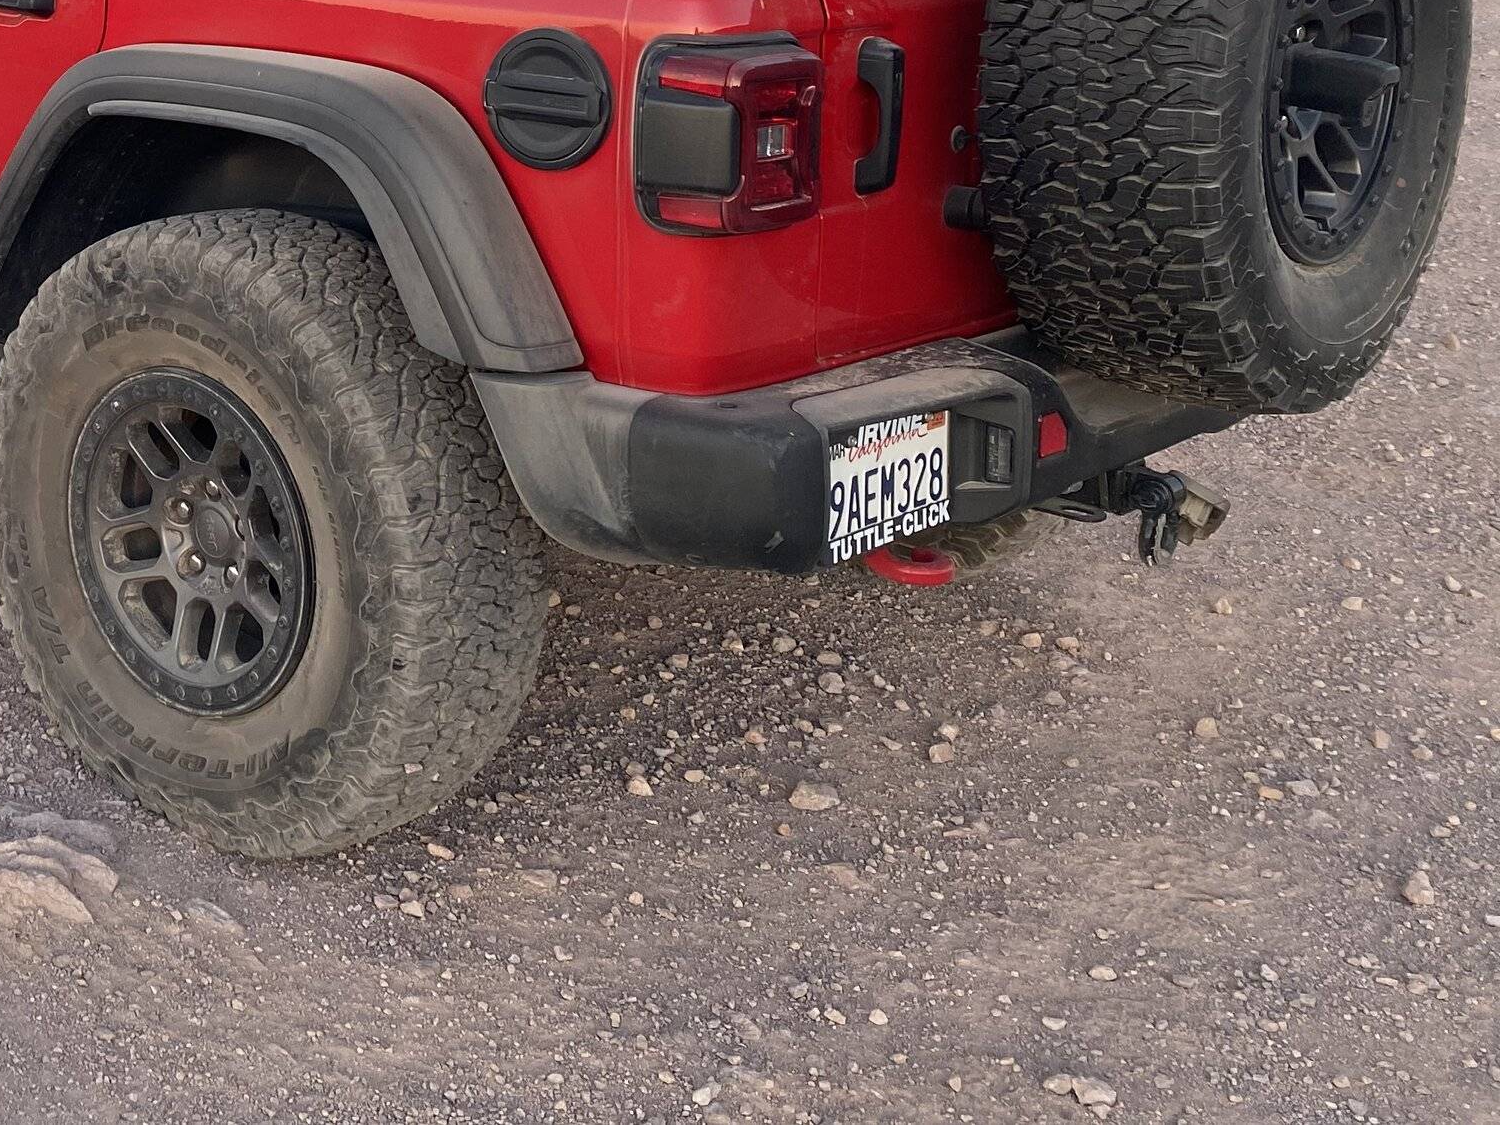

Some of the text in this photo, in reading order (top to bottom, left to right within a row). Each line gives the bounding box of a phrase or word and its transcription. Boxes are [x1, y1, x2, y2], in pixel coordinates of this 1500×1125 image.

[857, 413, 924, 448] IRVINE
[829, 446, 944, 540] 9AEM328
[829, 499, 951, 565] TUTTLE-CLICK
